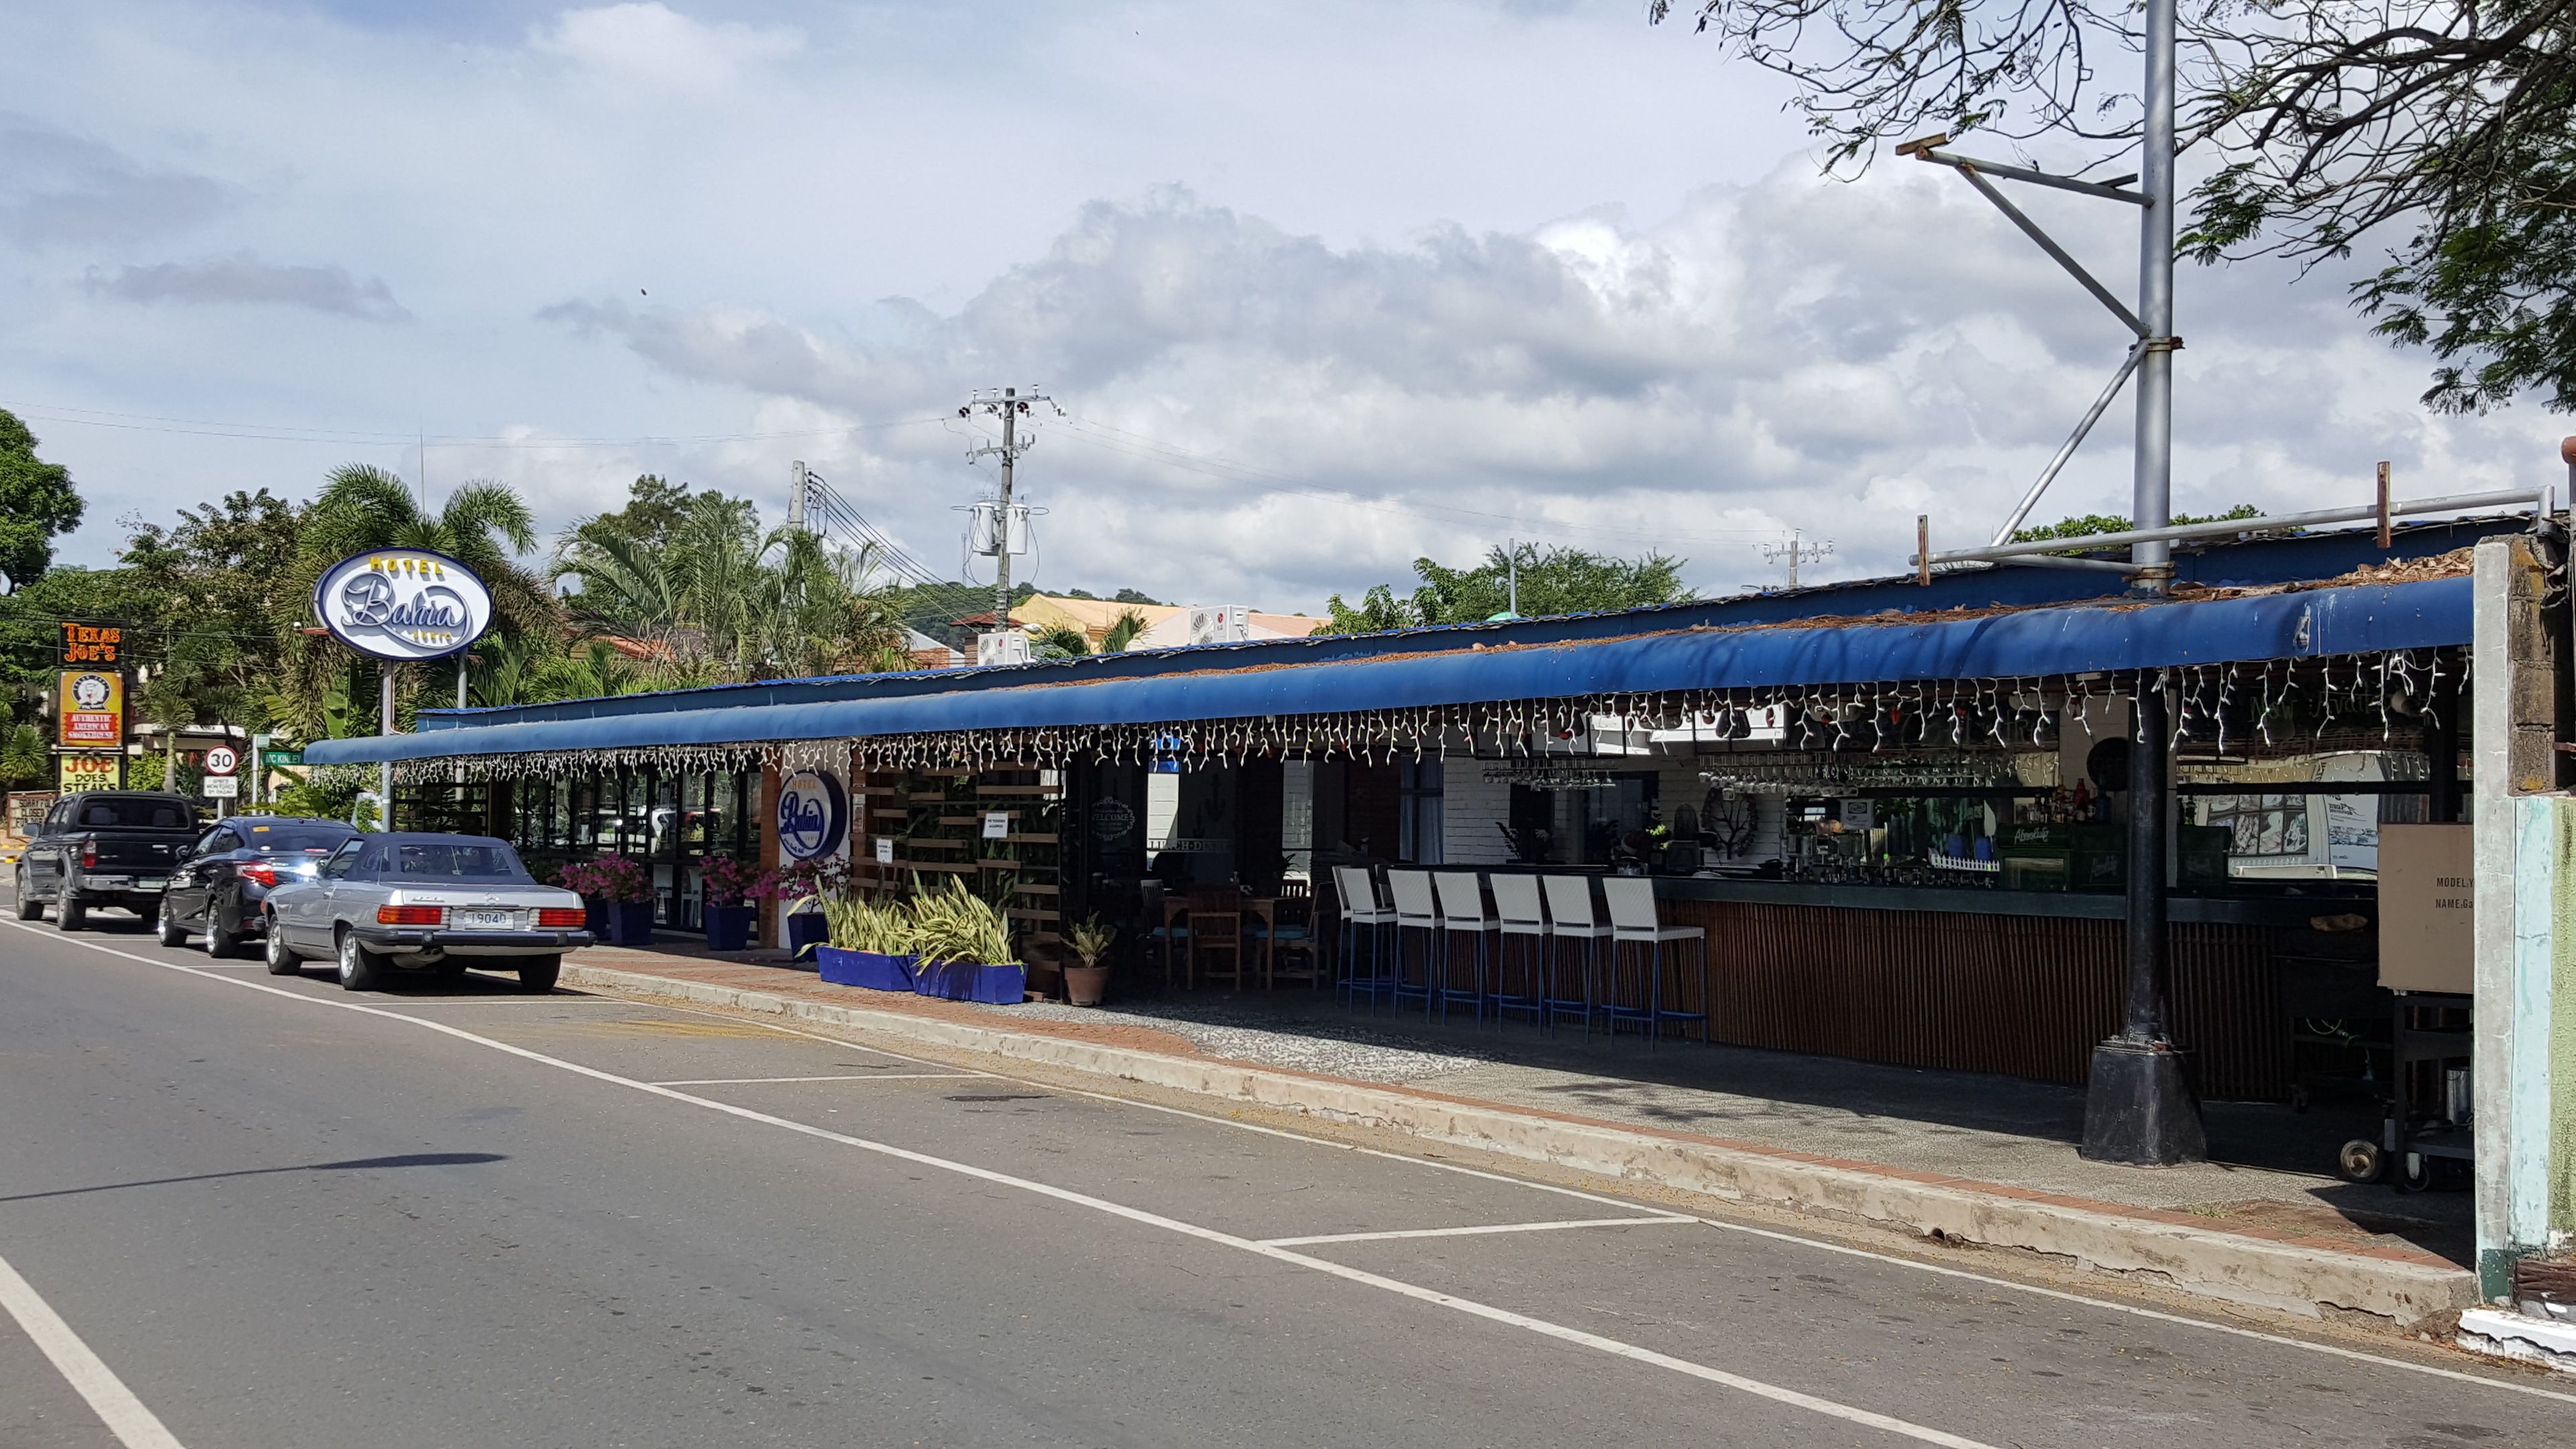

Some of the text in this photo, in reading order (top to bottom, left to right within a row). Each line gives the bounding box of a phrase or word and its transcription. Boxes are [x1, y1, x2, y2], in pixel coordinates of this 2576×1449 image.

[370, 556, 443, 574] HOTEL
[341, 572, 472, 649] Bahia
[62, 622, 120, 643] TEXAS
[64, 643, 115, 662] JOE'S
[211, 753, 232, 767] 30
[265, 754, 302, 763] MC KINLEY
[65, 756, 114, 773] JOE
[75, 773, 107, 782] DOES
[64, 782, 117, 793] STEAKS
[792, 780, 817, 790] HOTEL
[19, 799, 38, 808] SORRY
[21, 808, 45, 817] CLOSED
[1092, 813, 1129, 821] ELCOME
